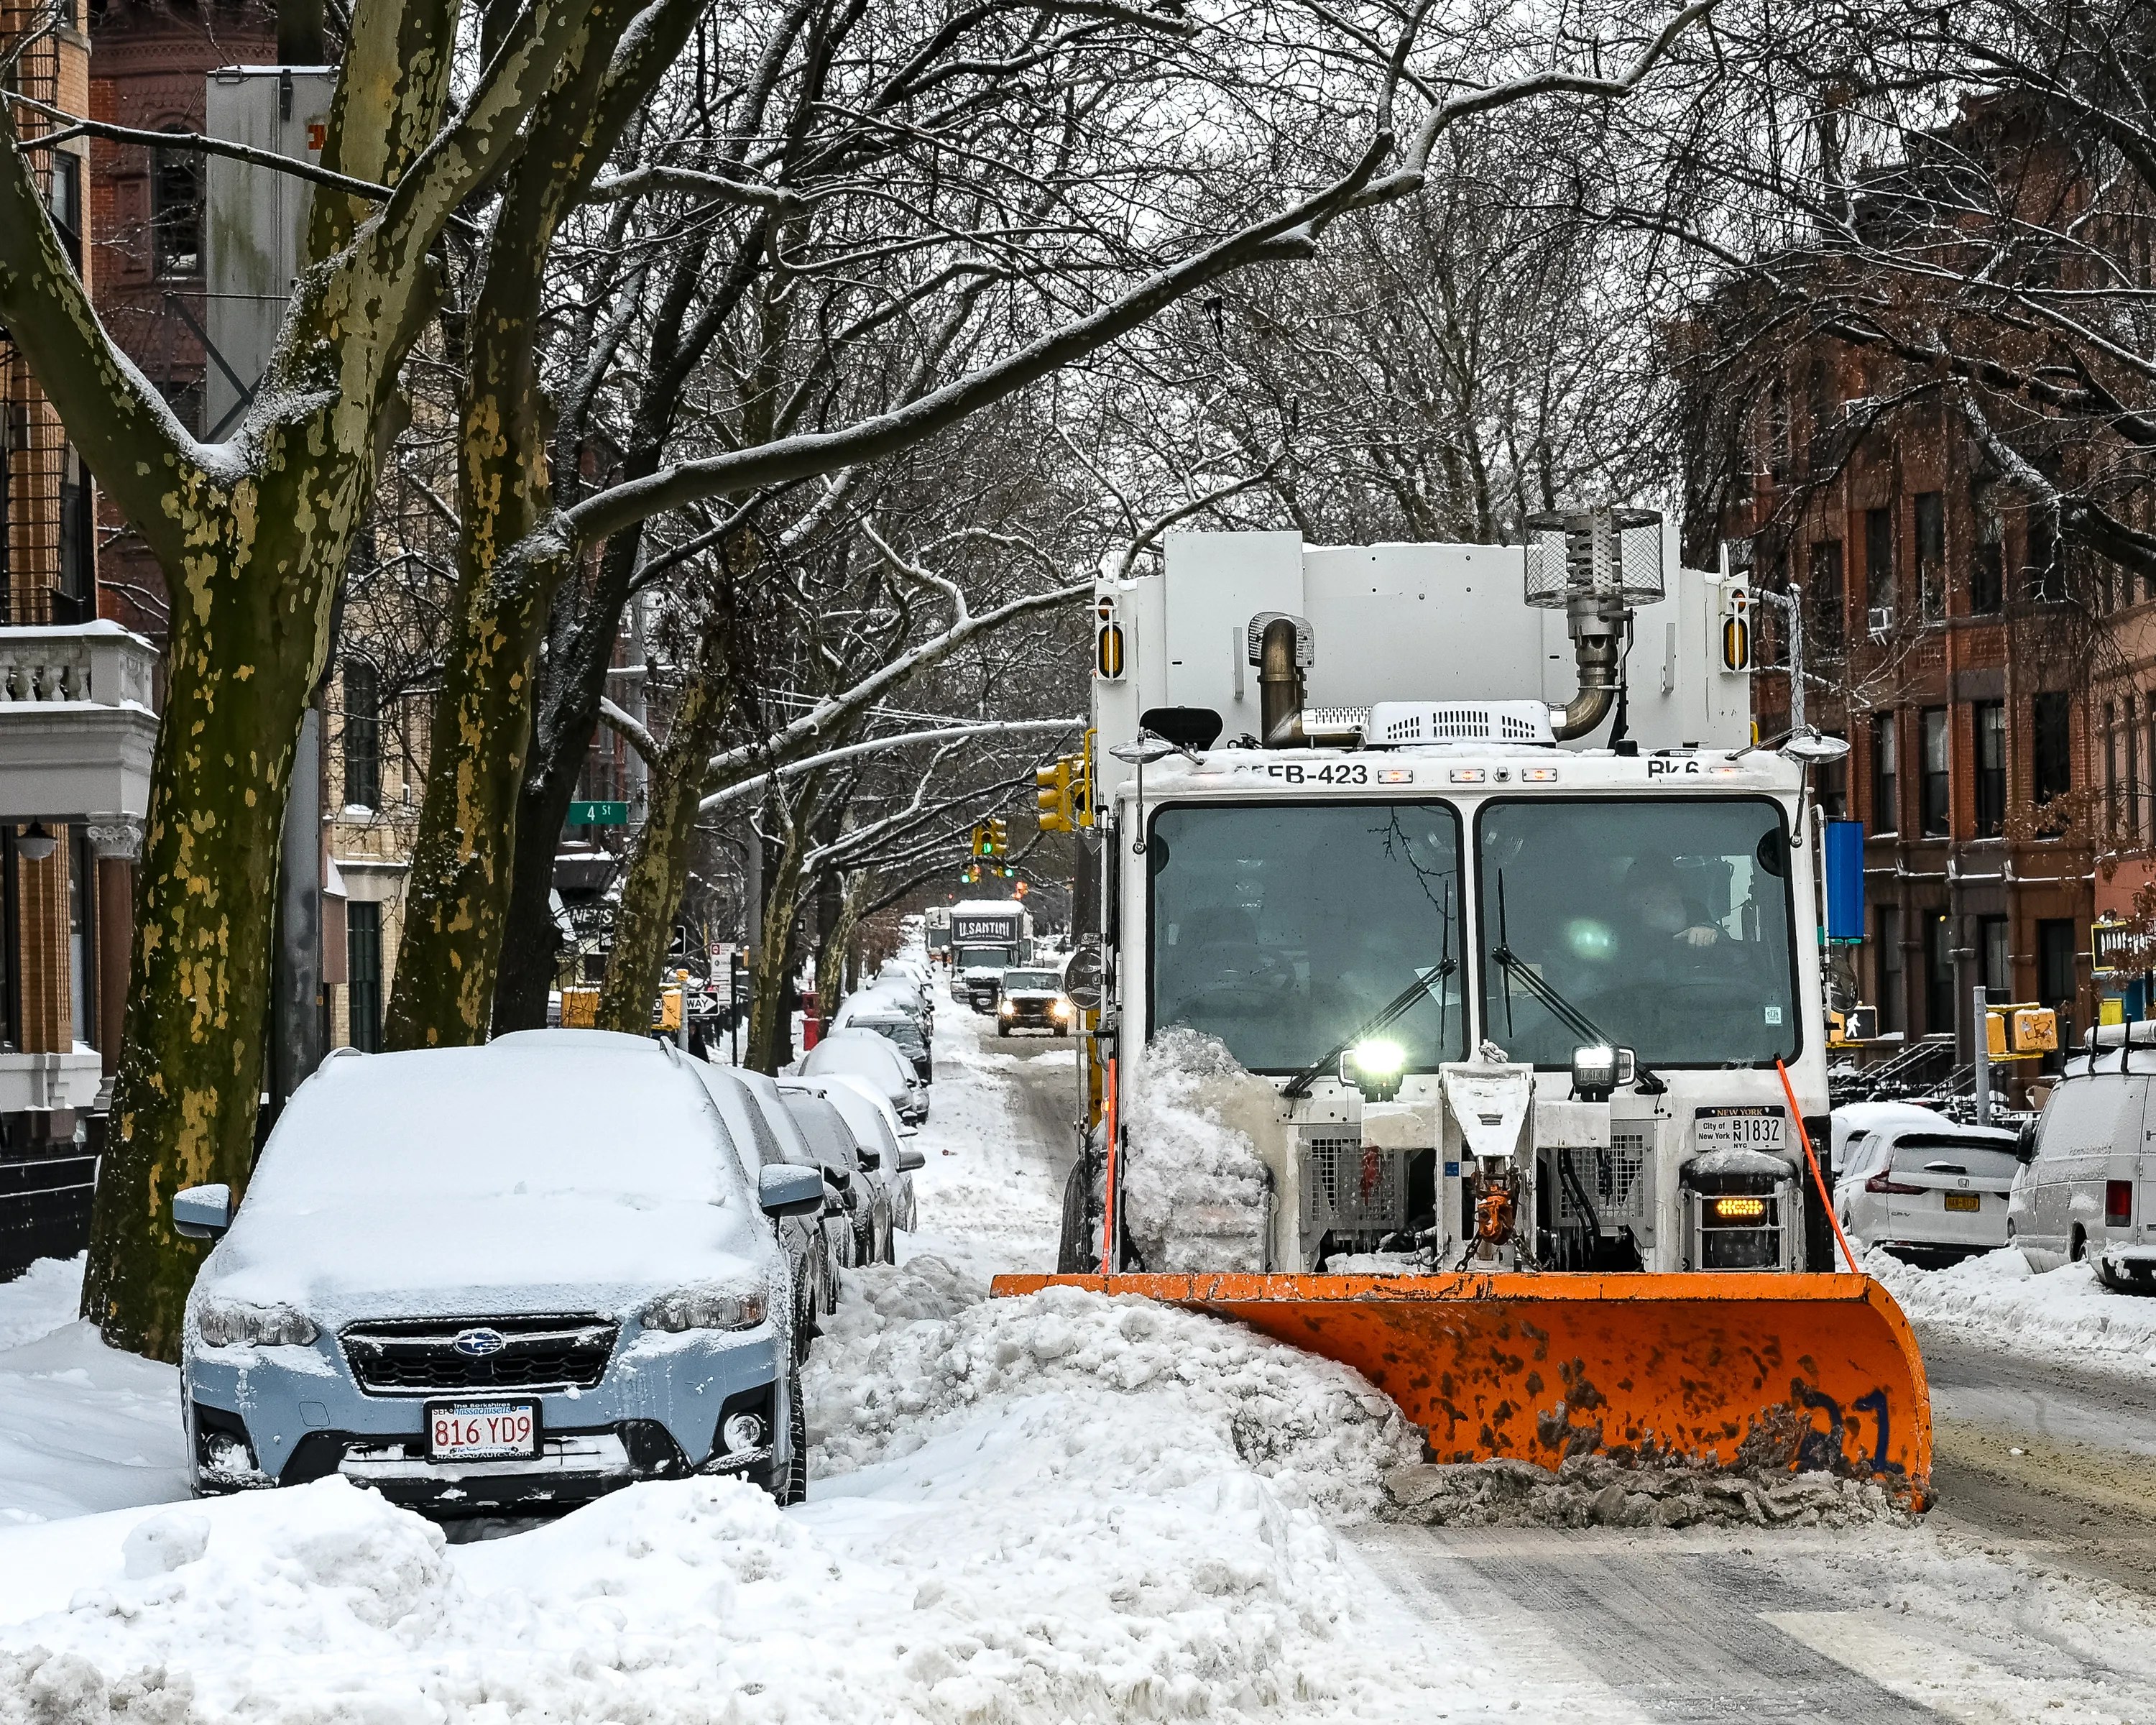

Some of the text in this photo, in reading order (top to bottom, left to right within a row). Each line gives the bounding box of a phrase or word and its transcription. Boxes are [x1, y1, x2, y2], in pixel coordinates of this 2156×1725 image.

[587, 805, 611, 821] 4 St
[959, 921, 1010, 937] U.SANTINI
[686, 999, 708, 1008] WAY
[436, 1416, 531, 1446] 816 YD9
